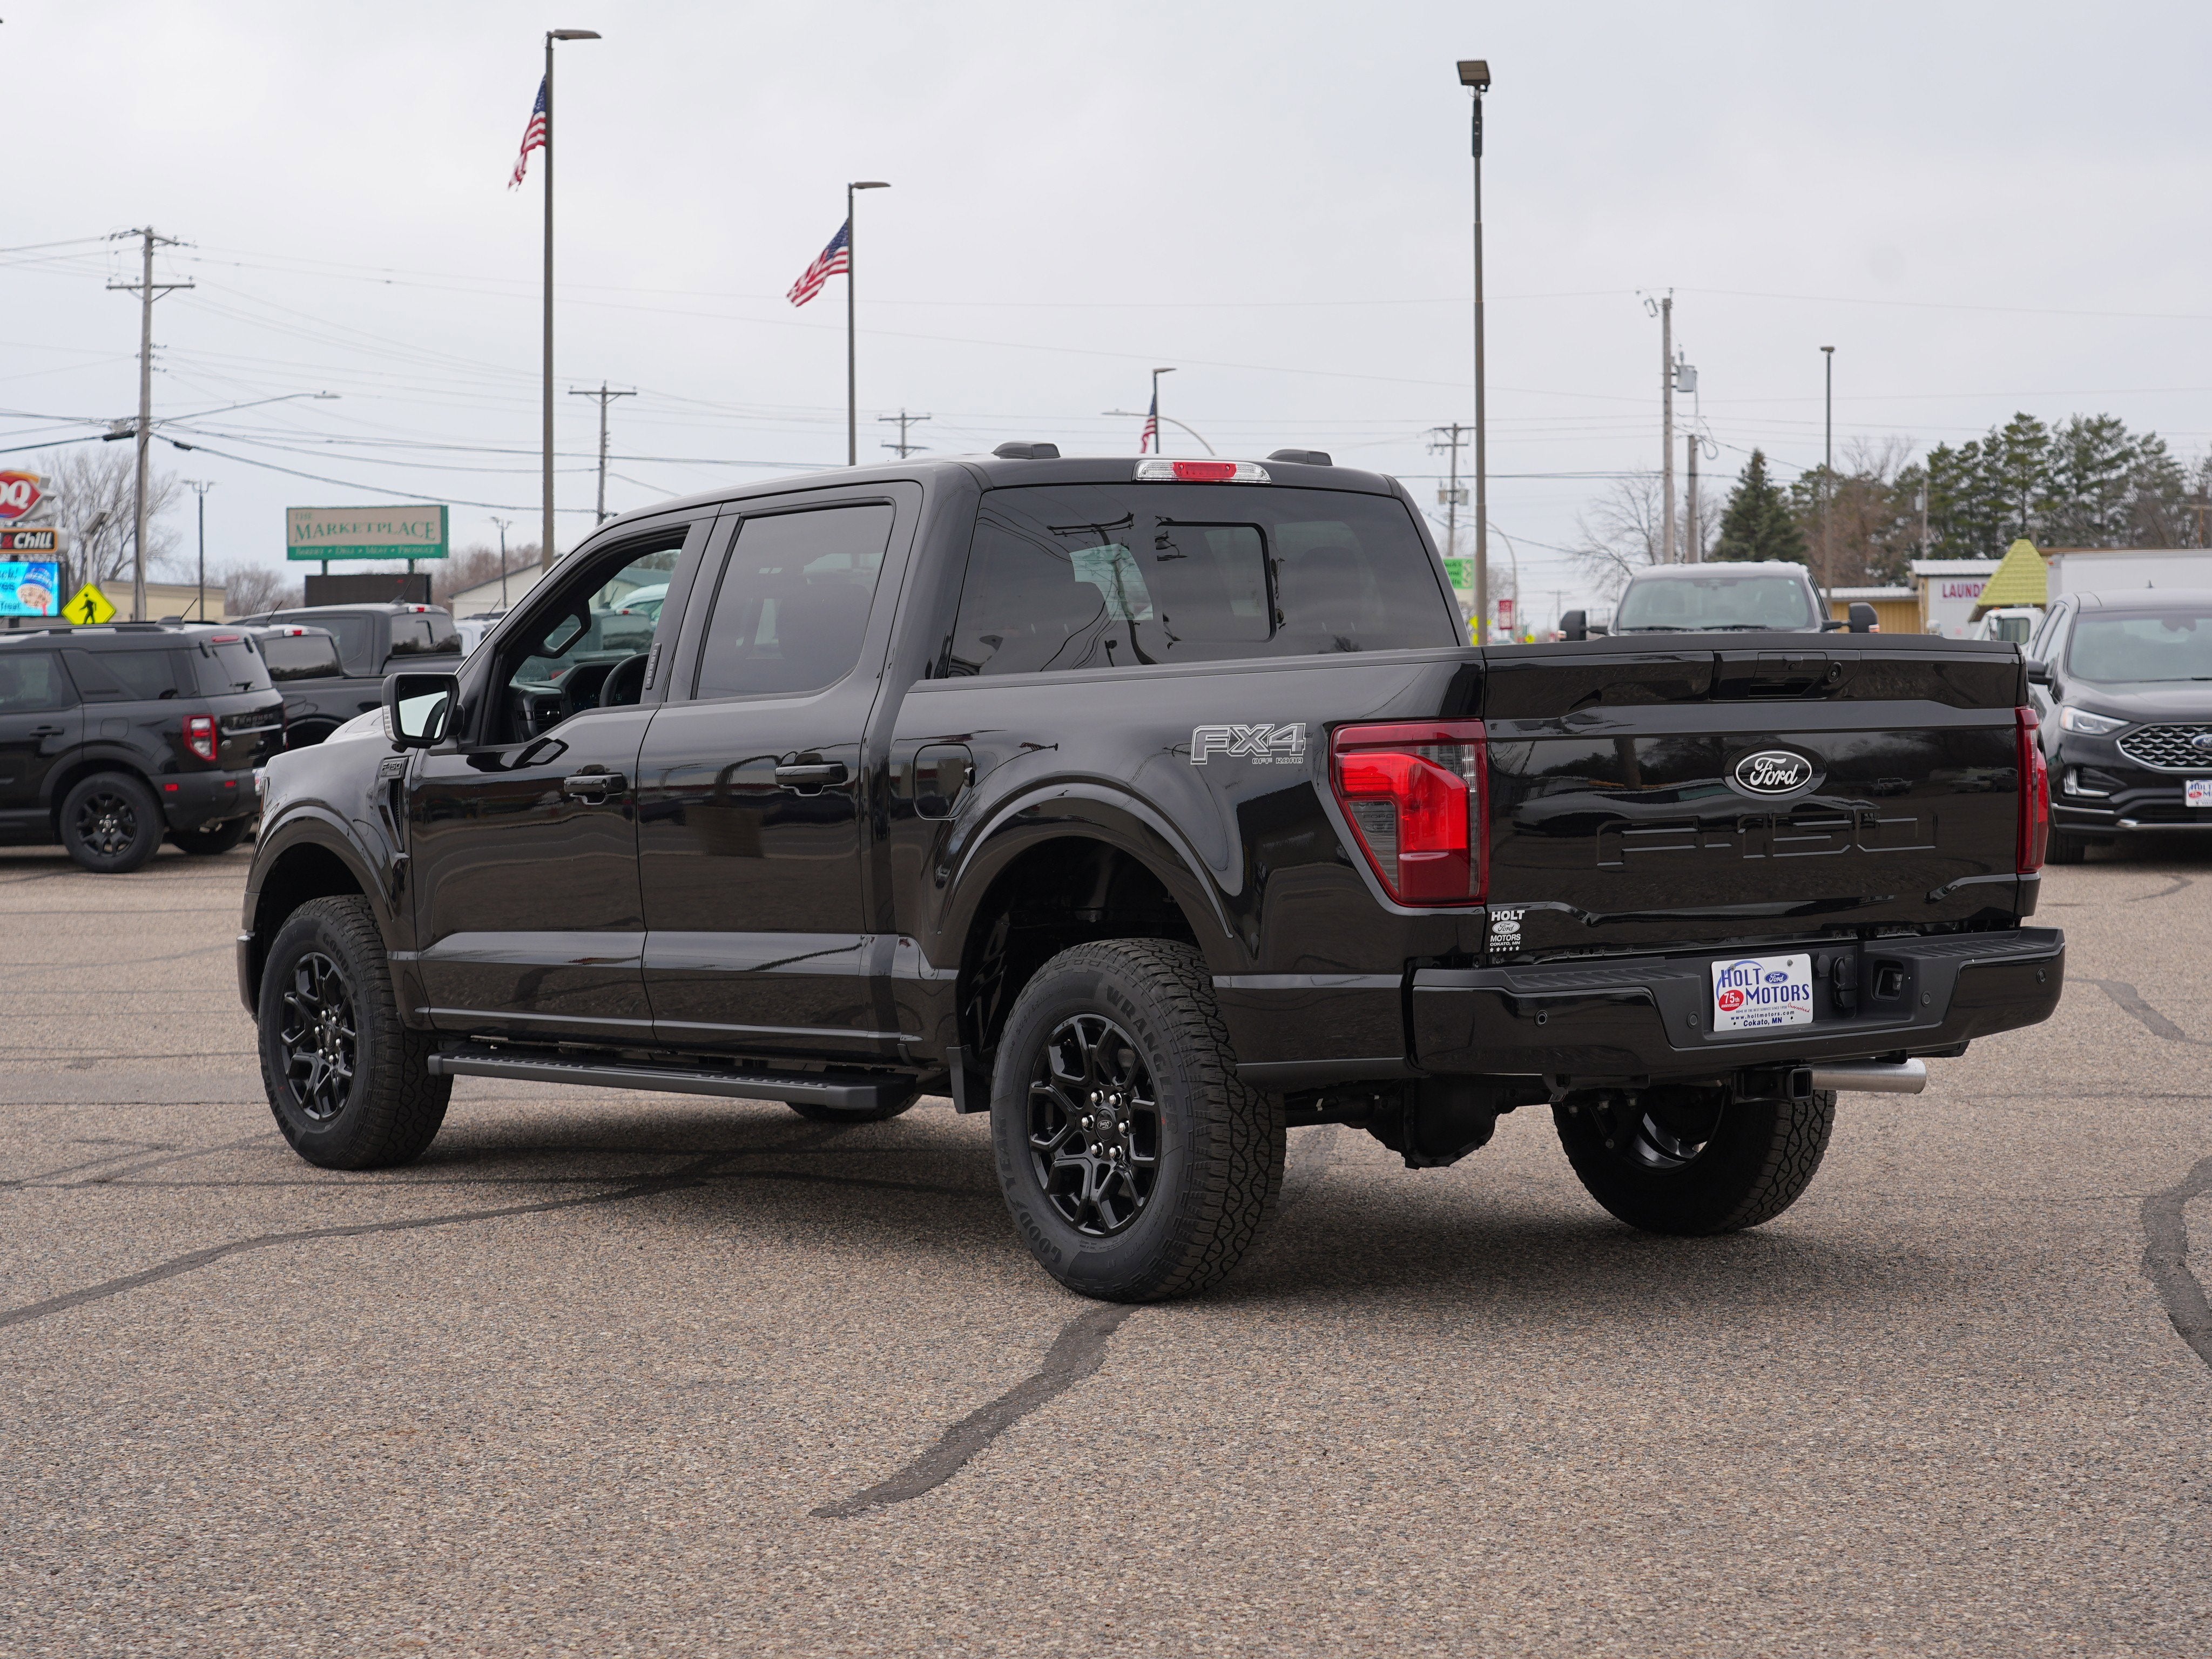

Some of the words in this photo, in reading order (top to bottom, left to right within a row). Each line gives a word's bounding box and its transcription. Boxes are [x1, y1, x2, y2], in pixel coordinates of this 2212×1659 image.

[13, 531, 53, 549] Chill
[294, 521, 436, 543] MARKETPLACE
[1190, 723, 1306, 765] FX4
[1749, 757, 1799, 786] Ford
[1596, 812, 1938, 866] F-150
[1491, 910, 1525, 921] HOLT
[1498, 923, 1515, 932] Ford
[1490, 934, 1521, 942] MOTORS
[1721, 968, 1762, 988] HOLT
[1769, 973, 1784, 982] Ford
[1724, 993, 1740, 1004] 75th
[1745, 984, 1810, 1006] MOTORS
[1731, 1010, 1795, 1020] www.holtmotors.com
[1788, 1002, 1810, 1013] Guaranteed
[1107, 984, 1178, 1134] WRANGLER
